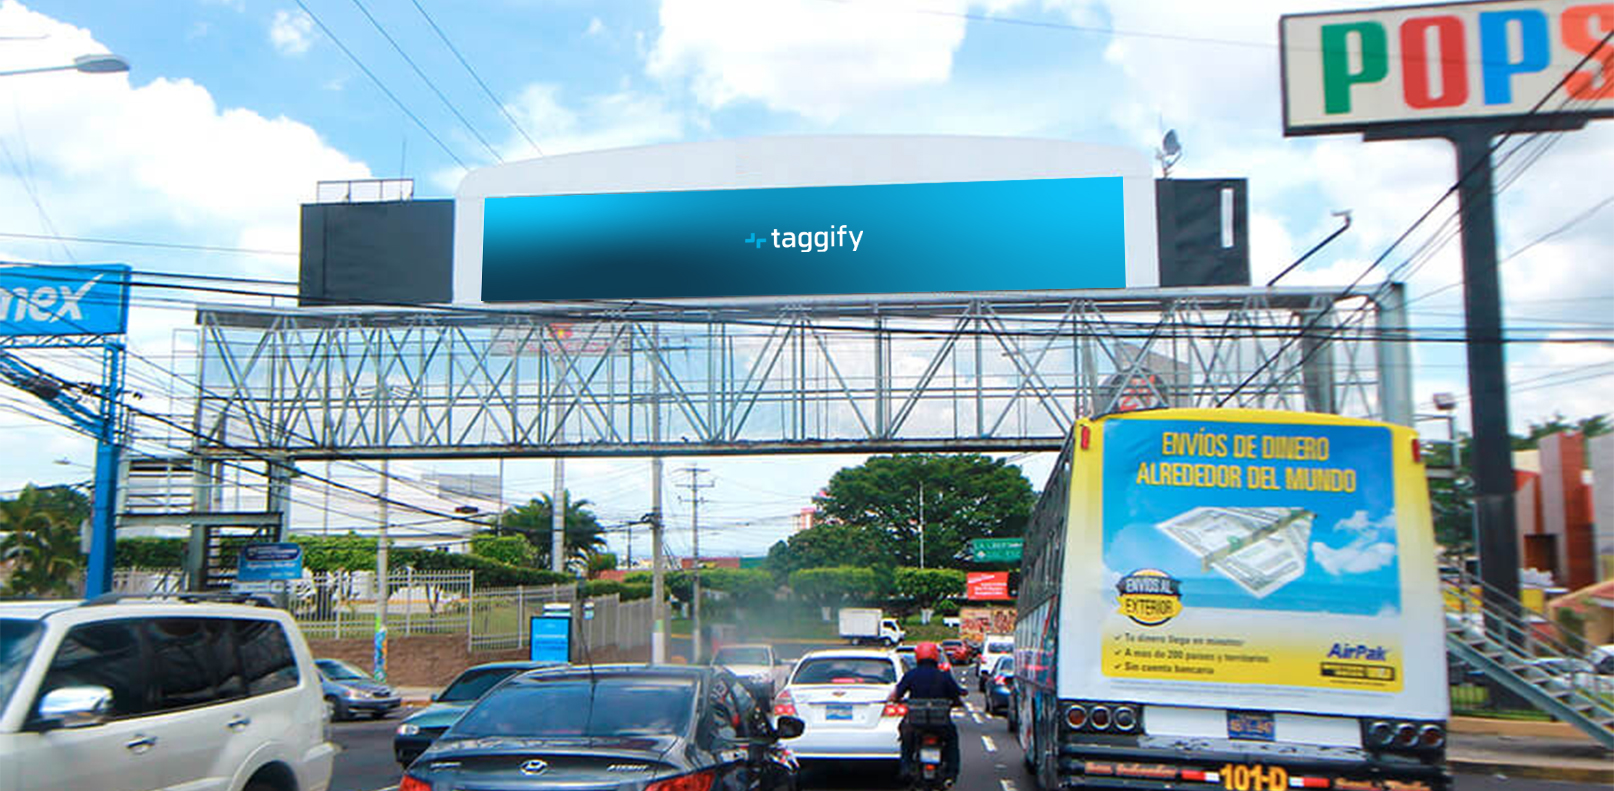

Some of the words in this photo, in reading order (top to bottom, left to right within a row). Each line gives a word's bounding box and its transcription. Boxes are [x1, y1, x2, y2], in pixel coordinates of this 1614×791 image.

[1321, 4, 1614, 115] POPS
[771, 225, 863, 252] taggify
[1162, 428, 1227, 457] ENVÍOS
[1234, 435, 1257, 459] DE
[1262, 437, 1329, 460] DINERO
[1136, 462, 1241, 489] ALREDEDOR
[1247, 466, 1280, 490] DEL
[1286, 468, 1356, 492] MUNDO
[1126, 597, 1172, 616] EXTERIOR
[1124, 648, 1131, 656] A
[1168, 650, 1184, 659] 200
[1327, 643, 1387, 661] AirPak
[1124, 662, 1139, 671] Sin
[1142, 664, 1172, 673] cuenta
[1174, 664, 1214, 674] bancaria
[1220, 763, 1288, 791] 101-D
